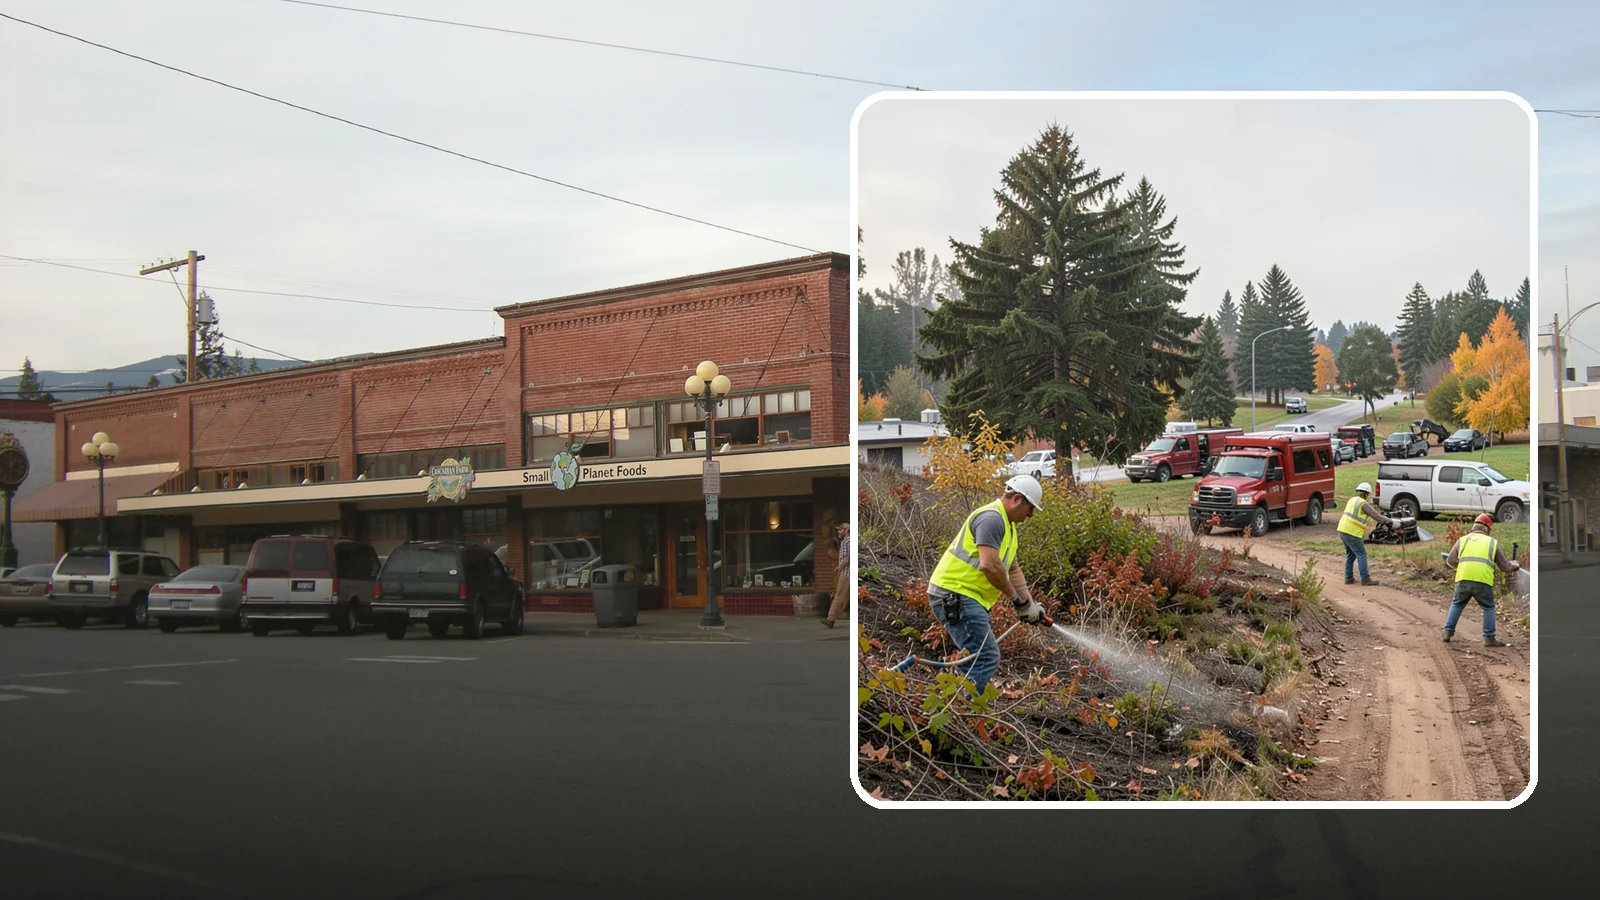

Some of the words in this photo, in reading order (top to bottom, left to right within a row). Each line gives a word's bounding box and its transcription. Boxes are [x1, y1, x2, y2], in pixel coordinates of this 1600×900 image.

[431, 466, 455, 476] CASCADIAN
[456, 465, 469, 474] FARM
[523, 471, 549, 483] Small
[582, 468, 614, 479] Planet
[616, 465, 647, 477] Foods
